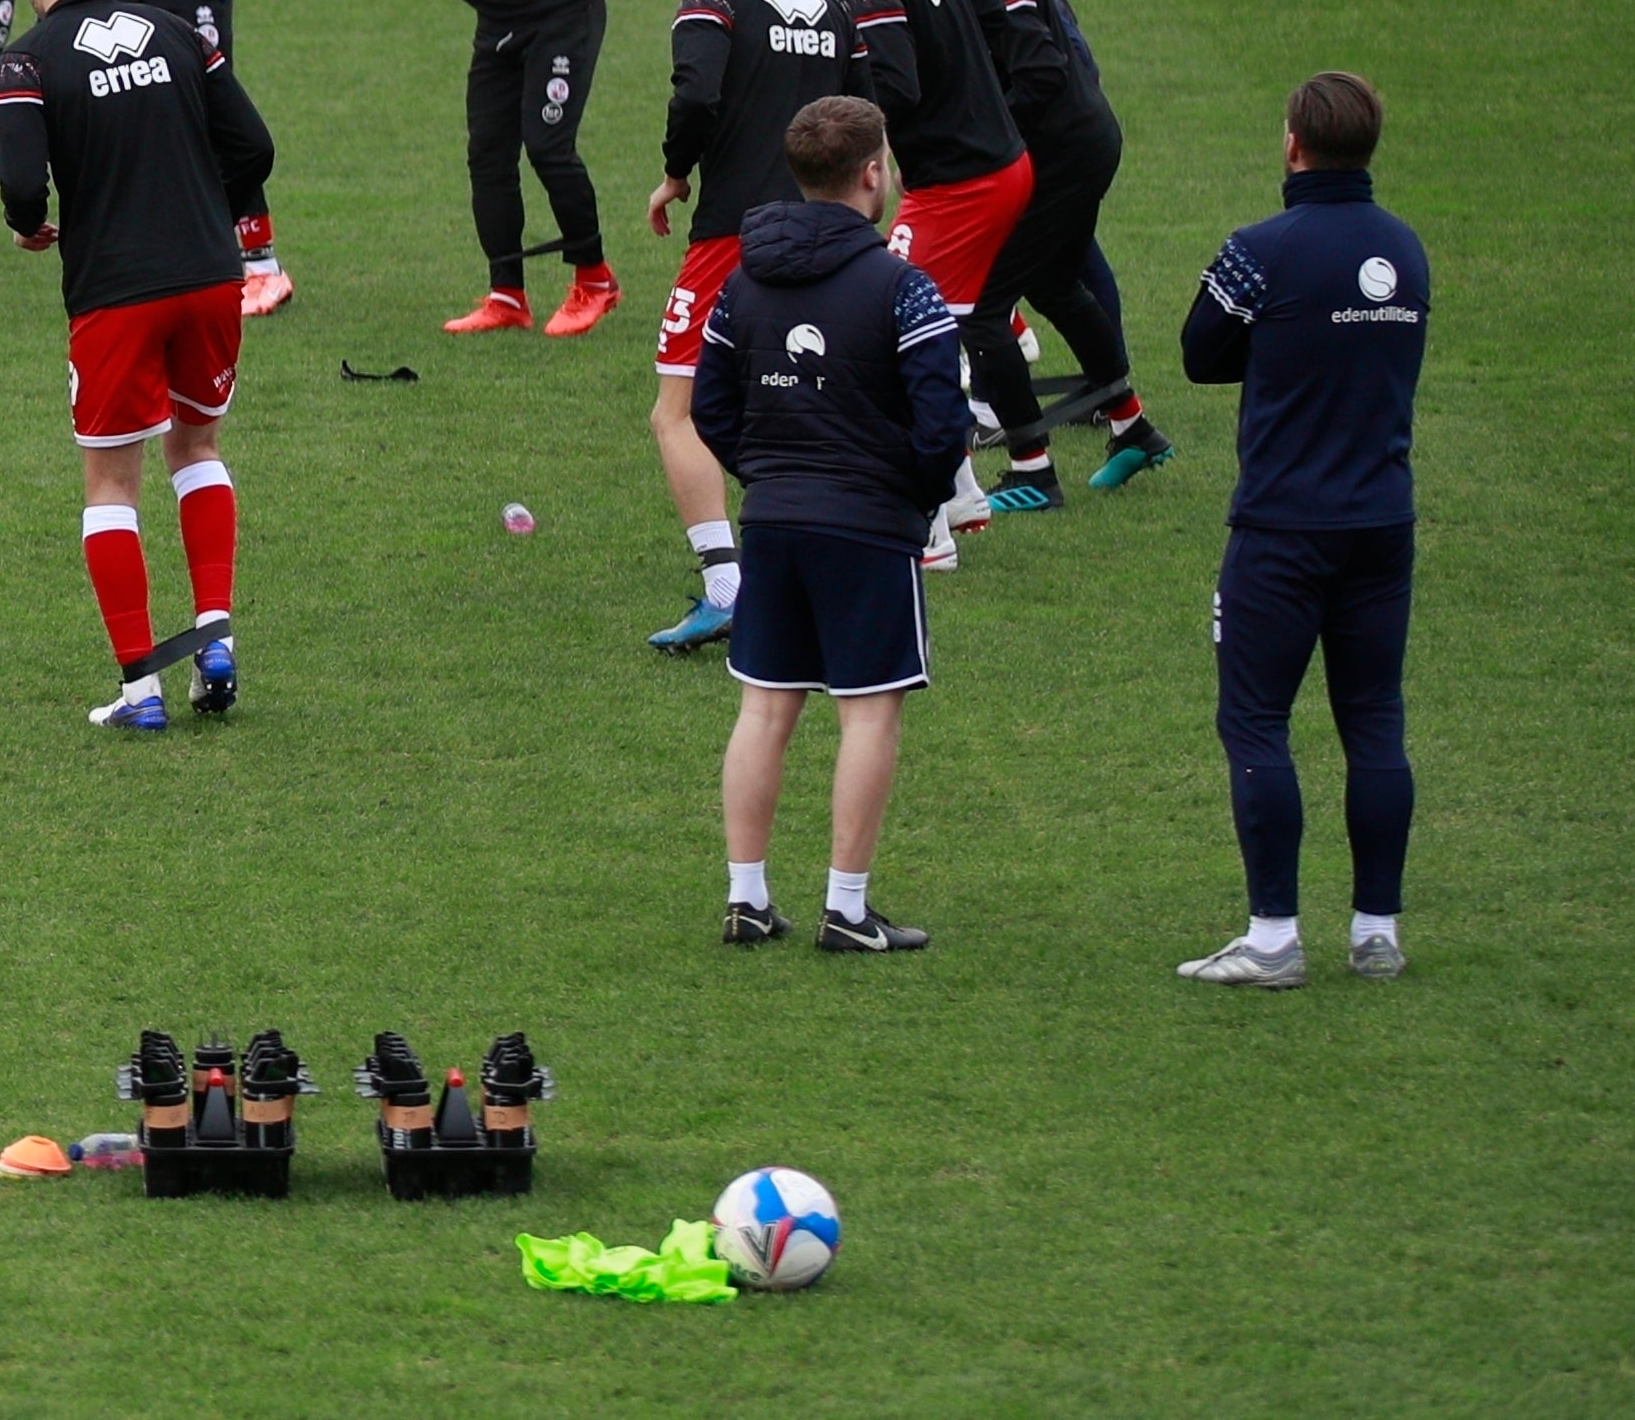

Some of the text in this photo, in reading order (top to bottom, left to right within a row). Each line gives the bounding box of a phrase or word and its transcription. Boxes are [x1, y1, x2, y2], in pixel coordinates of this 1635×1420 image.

[769, 25, 836, 58] errea
[89, 56, 172, 98] errea
[1331, 307, 1419, 323] edenutilities
